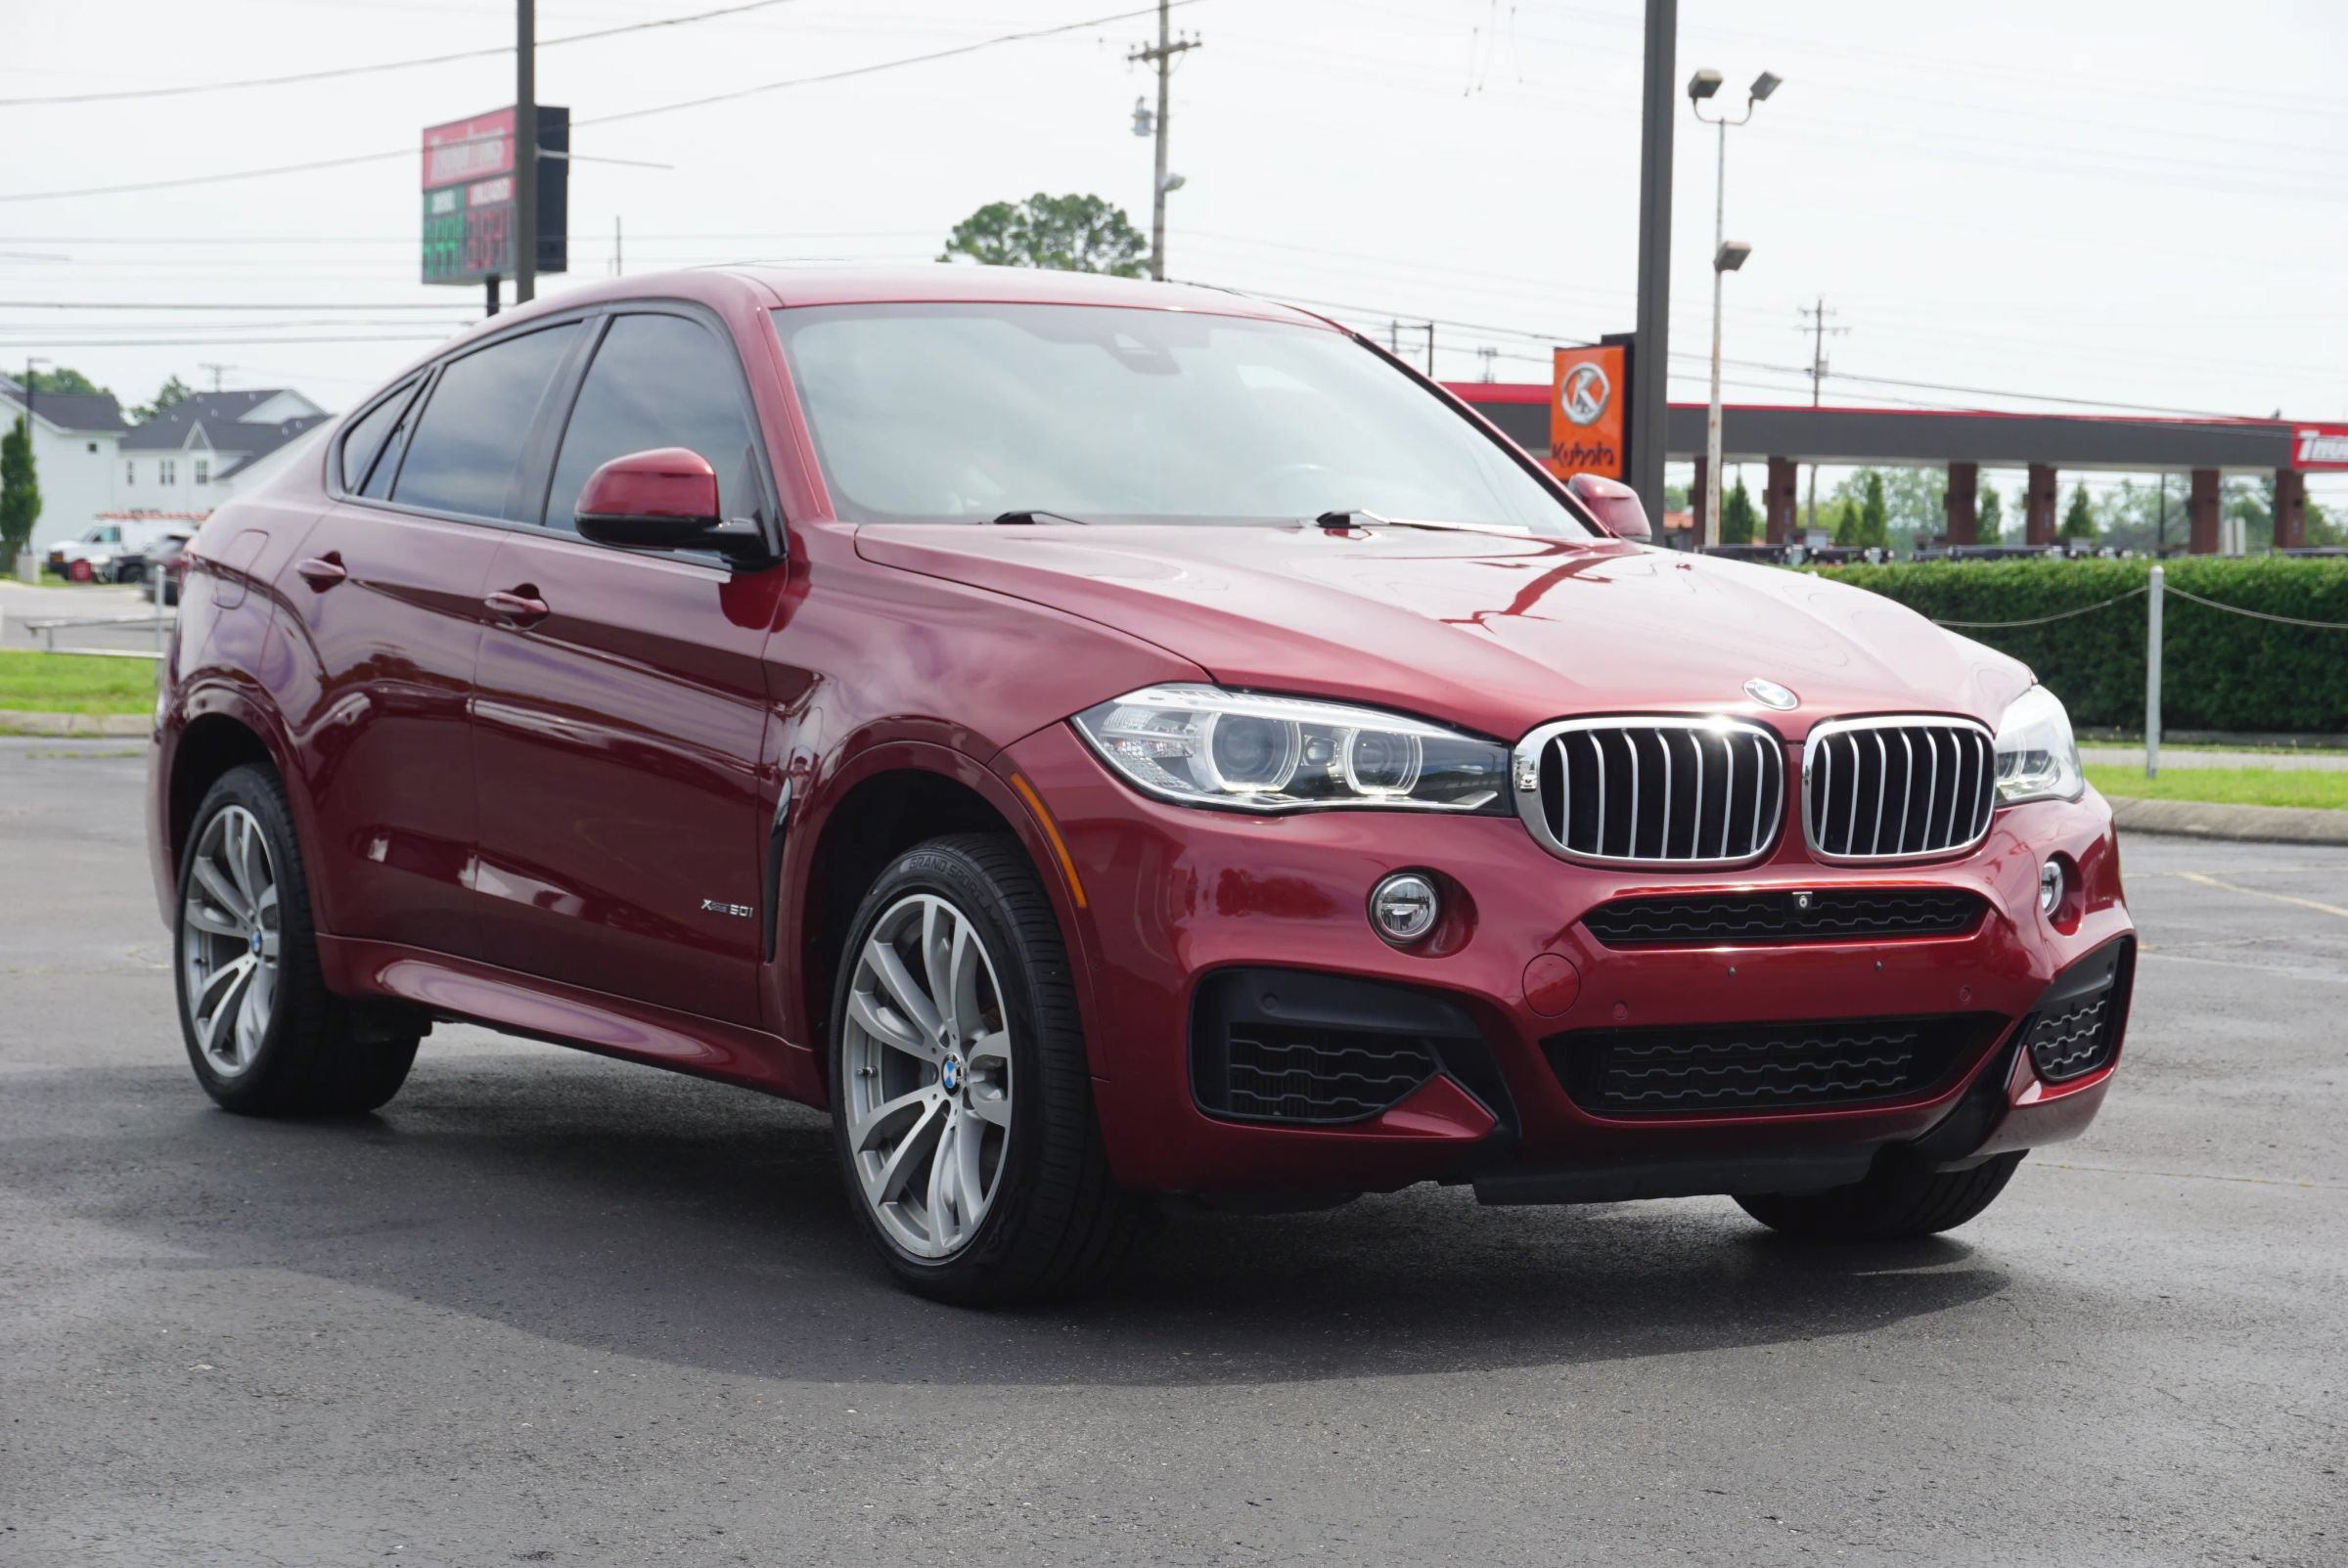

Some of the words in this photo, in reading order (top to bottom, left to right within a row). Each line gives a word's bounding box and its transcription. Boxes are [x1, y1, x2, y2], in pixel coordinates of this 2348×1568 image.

[1552, 439, 1615, 468] Kubota
[910, 857, 948, 873] GRAND
[947, 865, 985, 901] SPORT
